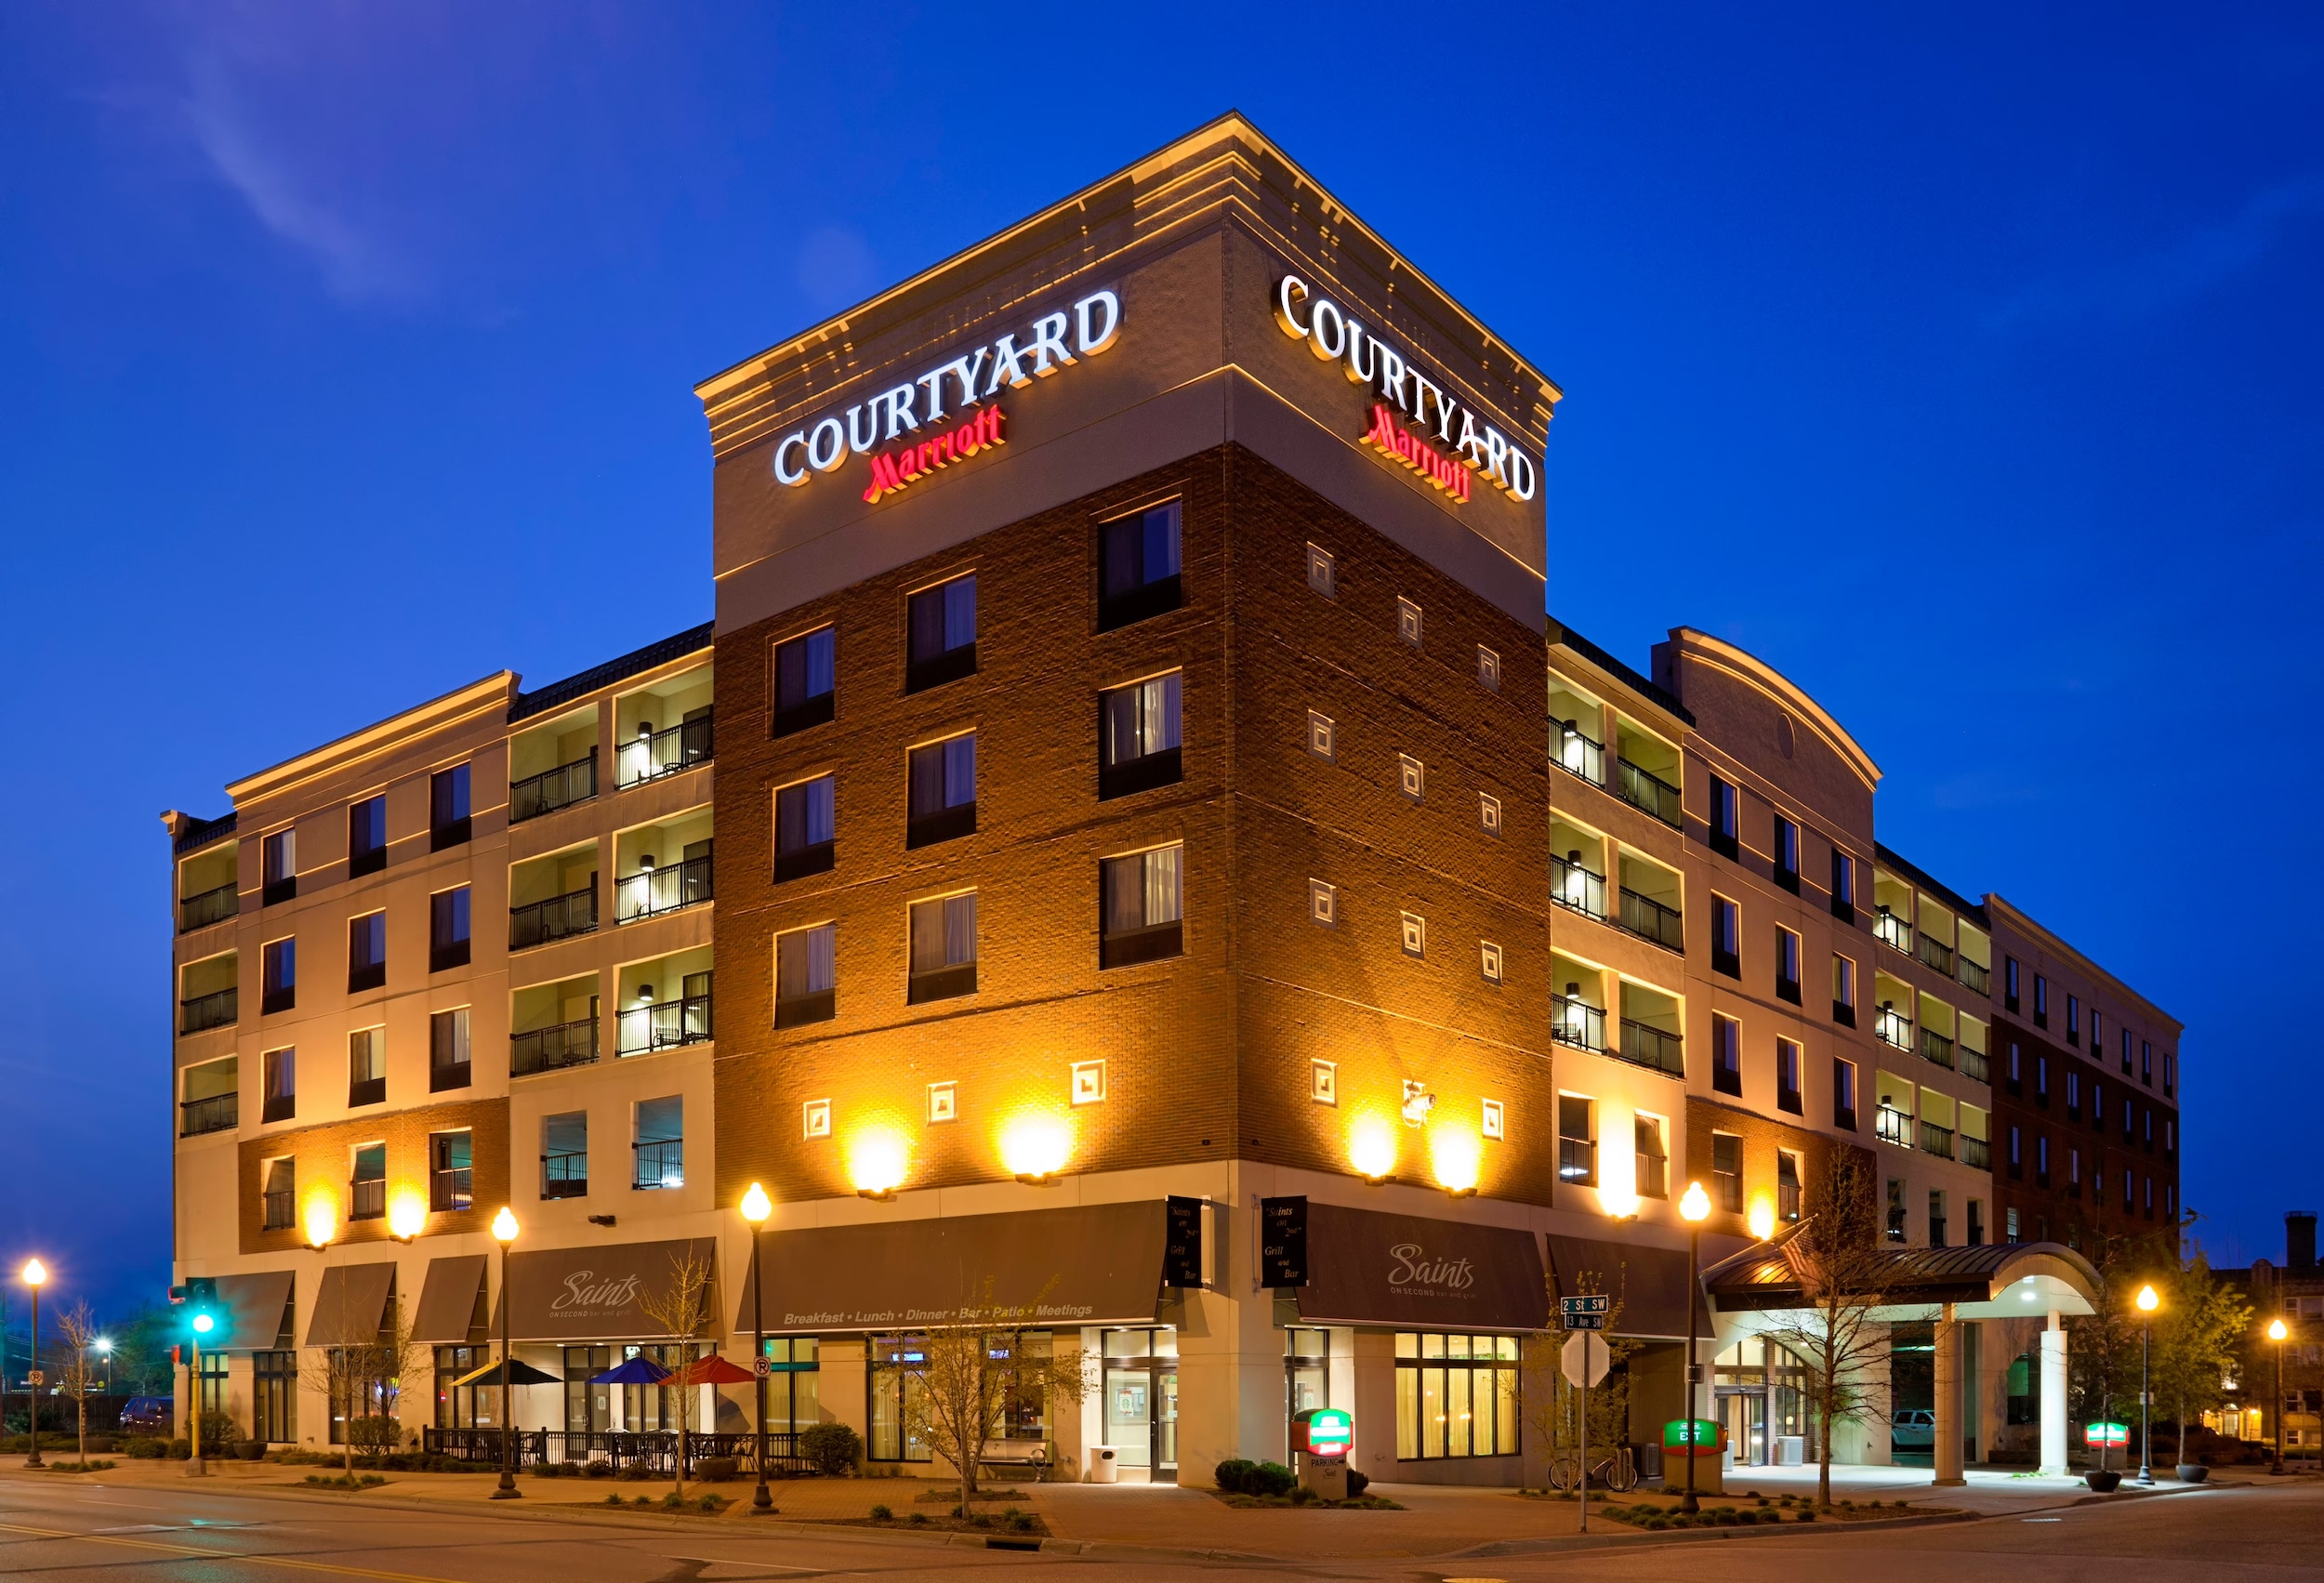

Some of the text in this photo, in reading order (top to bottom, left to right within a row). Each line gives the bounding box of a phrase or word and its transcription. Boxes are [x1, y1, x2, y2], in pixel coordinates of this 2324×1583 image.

[773, 290, 1120, 486] COURTYARD
[1280, 275, 1536, 501] COURTYARD
[862, 403, 1004, 502] Marriott
[1368, 404, 1471, 503] Marriott
[1170, 1246, 1185, 1255] Grill
[1264, 1246, 1284, 1255] Grill
[1387, 1243, 1475, 1290] Saints
[1184, 1270, 1196, 1280] Bar
[1284, 1269, 1300, 1278] Bar
[550, 1270, 641, 1310] Saints
[1404, 1287, 1434, 1297] SECOND
[1564, 1299, 1604, 1312] 2 St SW
[784, 1304, 1093, 1325] Breakfast Lunch Dinner Bar Patio Meetings
[1567, 1315, 1601, 1327] 13 Ave SW
[1311, 1458, 1339, 1467] PARKING
